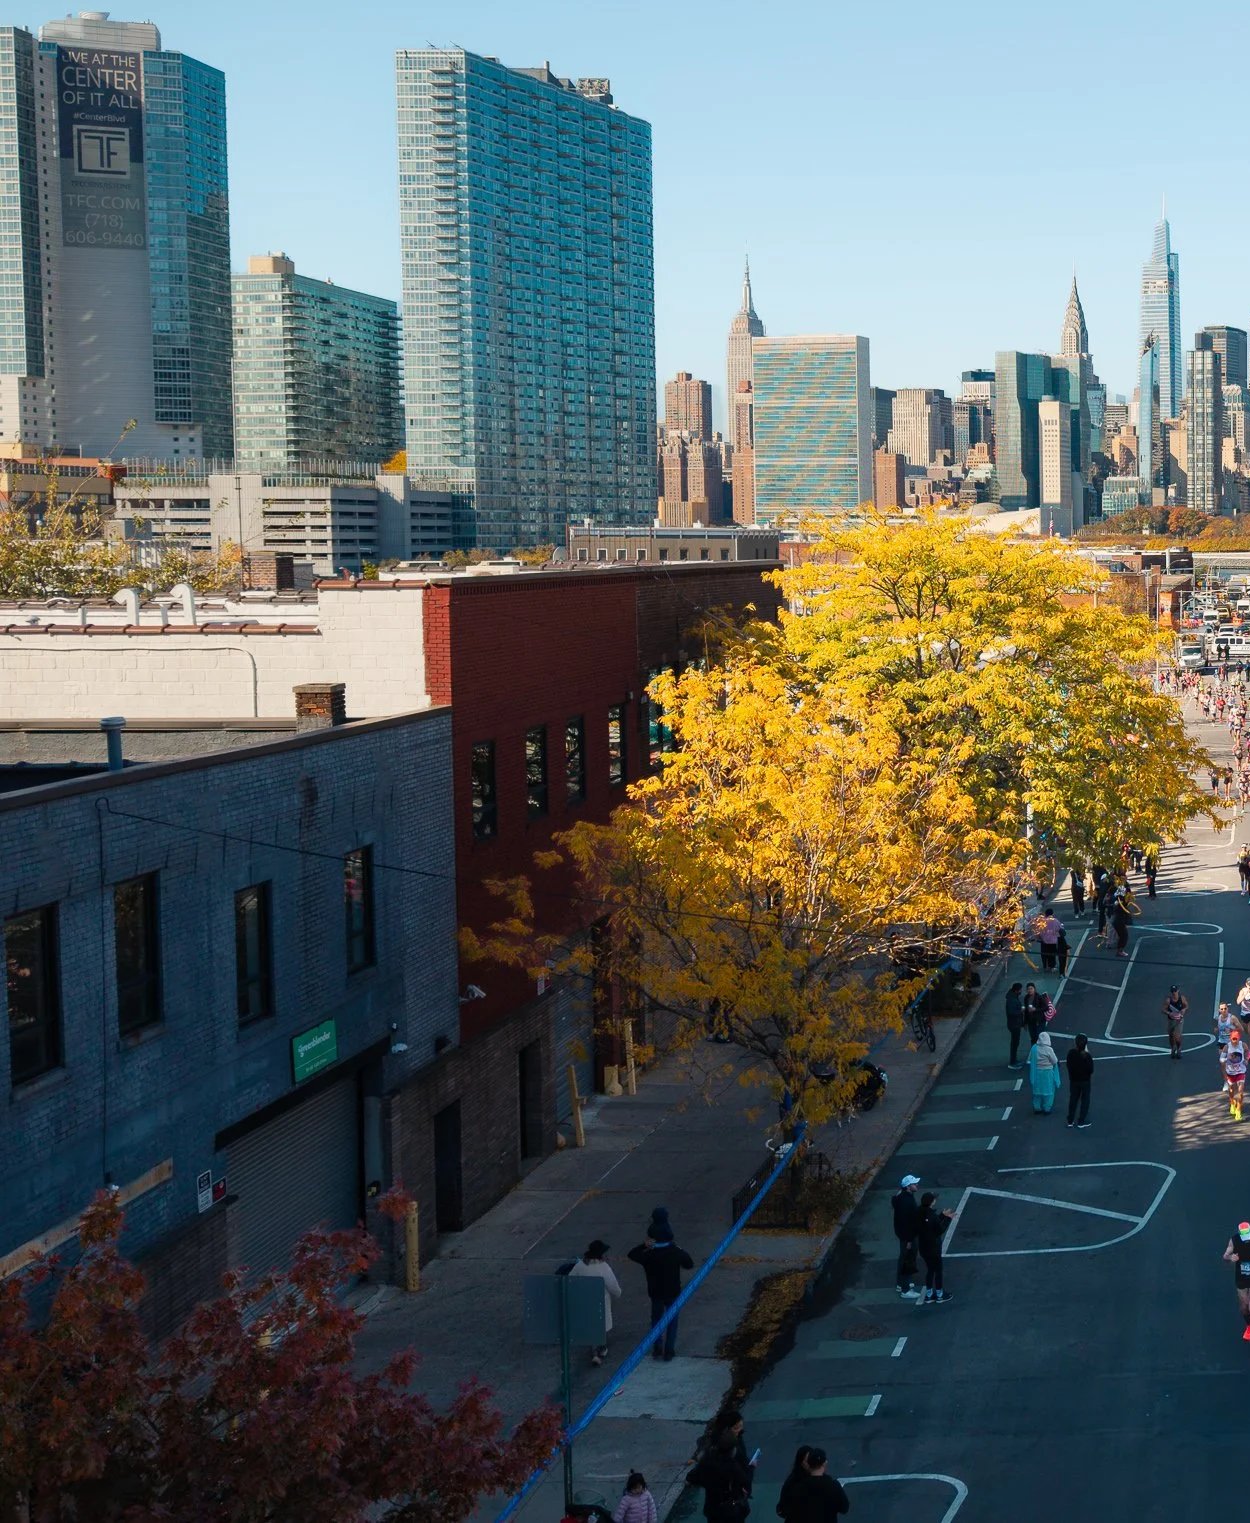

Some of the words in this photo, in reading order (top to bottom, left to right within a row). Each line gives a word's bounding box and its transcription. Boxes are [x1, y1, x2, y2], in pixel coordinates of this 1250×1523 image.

[62, 51, 88, 64] LIVE
[92, 53, 108, 65] AT
[110, 55, 135, 68] THE
[62, 67, 137, 91] CENTER
[62, 90, 86, 105] OF
[91, 92, 104, 106] IT
[109, 94, 138, 109] ALL
[73, 112, 126, 123] #CenterBlvd
[65, 194, 140, 211] TFC.COM
[85, 213, 123, 230] (718)
